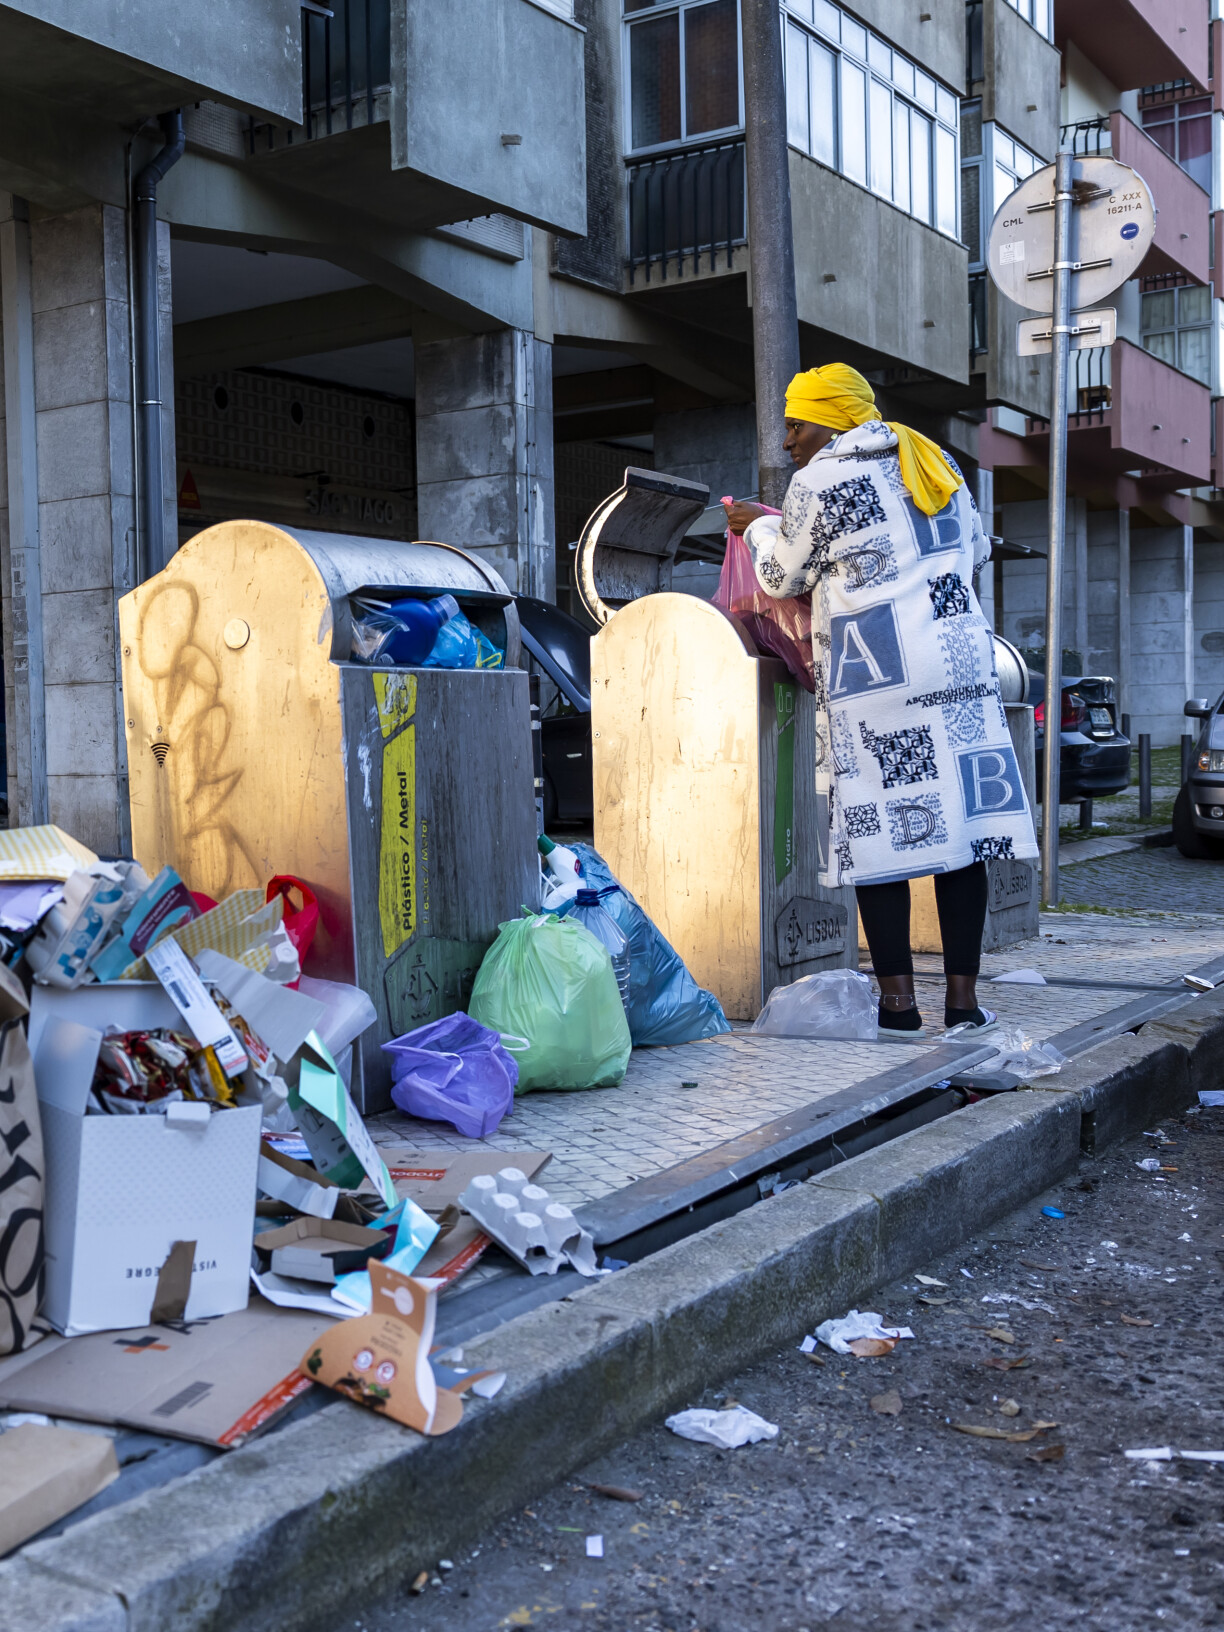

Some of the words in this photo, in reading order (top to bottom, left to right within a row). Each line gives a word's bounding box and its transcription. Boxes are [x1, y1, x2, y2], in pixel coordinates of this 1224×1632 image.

[1122, 191, 1142, 202] XXX
[1107, 203, 1143, 215] 16211-A
[1002, 217, 1024, 228] CML
[397, 771, 409, 829] Metal
[401, 851, 413, 931] Plástico
[806, 916, 842, 945] LISBOA
